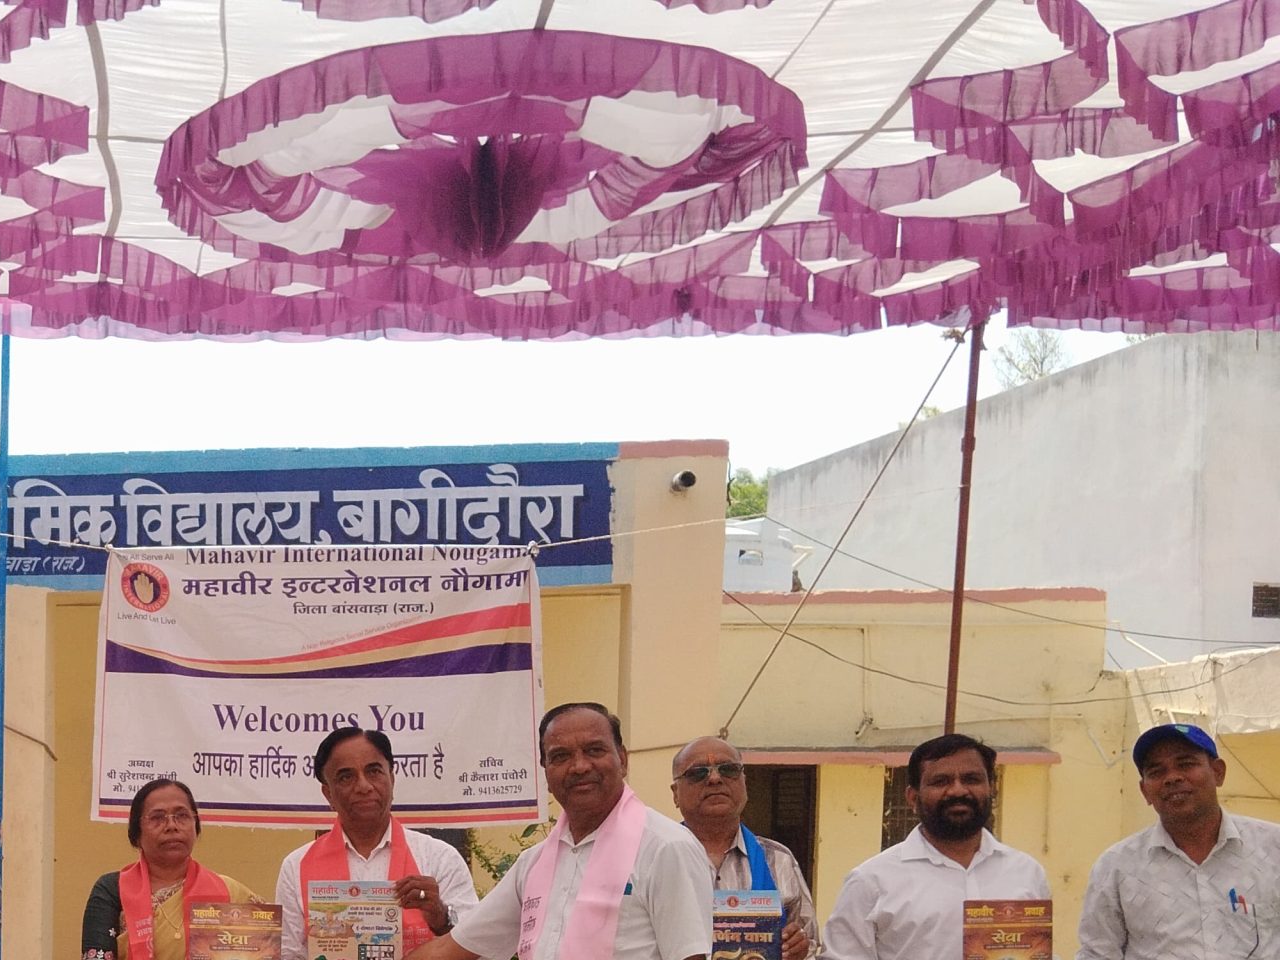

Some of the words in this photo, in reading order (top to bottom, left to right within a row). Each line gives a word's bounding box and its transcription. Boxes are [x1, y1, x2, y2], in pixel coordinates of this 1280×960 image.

[333, 463, 584, 546] बागीदौरा
[184, 547, 276, 566] Mahavir
[282, 546, 424, 564] International
[182, 571, 272, 597] महावीर
[282, 569, 431, 598] इन्टरनेशनल
[440, 567, 529, 592] नौगामा
[293, 602, 327, 614] जिला
[332, 601, 388, 615] बांसवाड़ा
[394, 602, 434, 615] (राज.)
[133, 612, 148, 620] And
[160, 616, 177, 625] Live
[212, 703, 359, 733] Welcomes
[368, 704, 425, 732] You
[192, 751, 244, 777] आपका
[248, 746, 297, 780] हार्दिक
[432, 742, 445, 780] है
[479, 757, 504, 768] सचिव
[470, 769, 499, 783] कैलाश
[478, 784, 522, 796] 9413625729
[217, 930, 251, 945] सेवा
[991, 929, 1024, 943] सेवा
